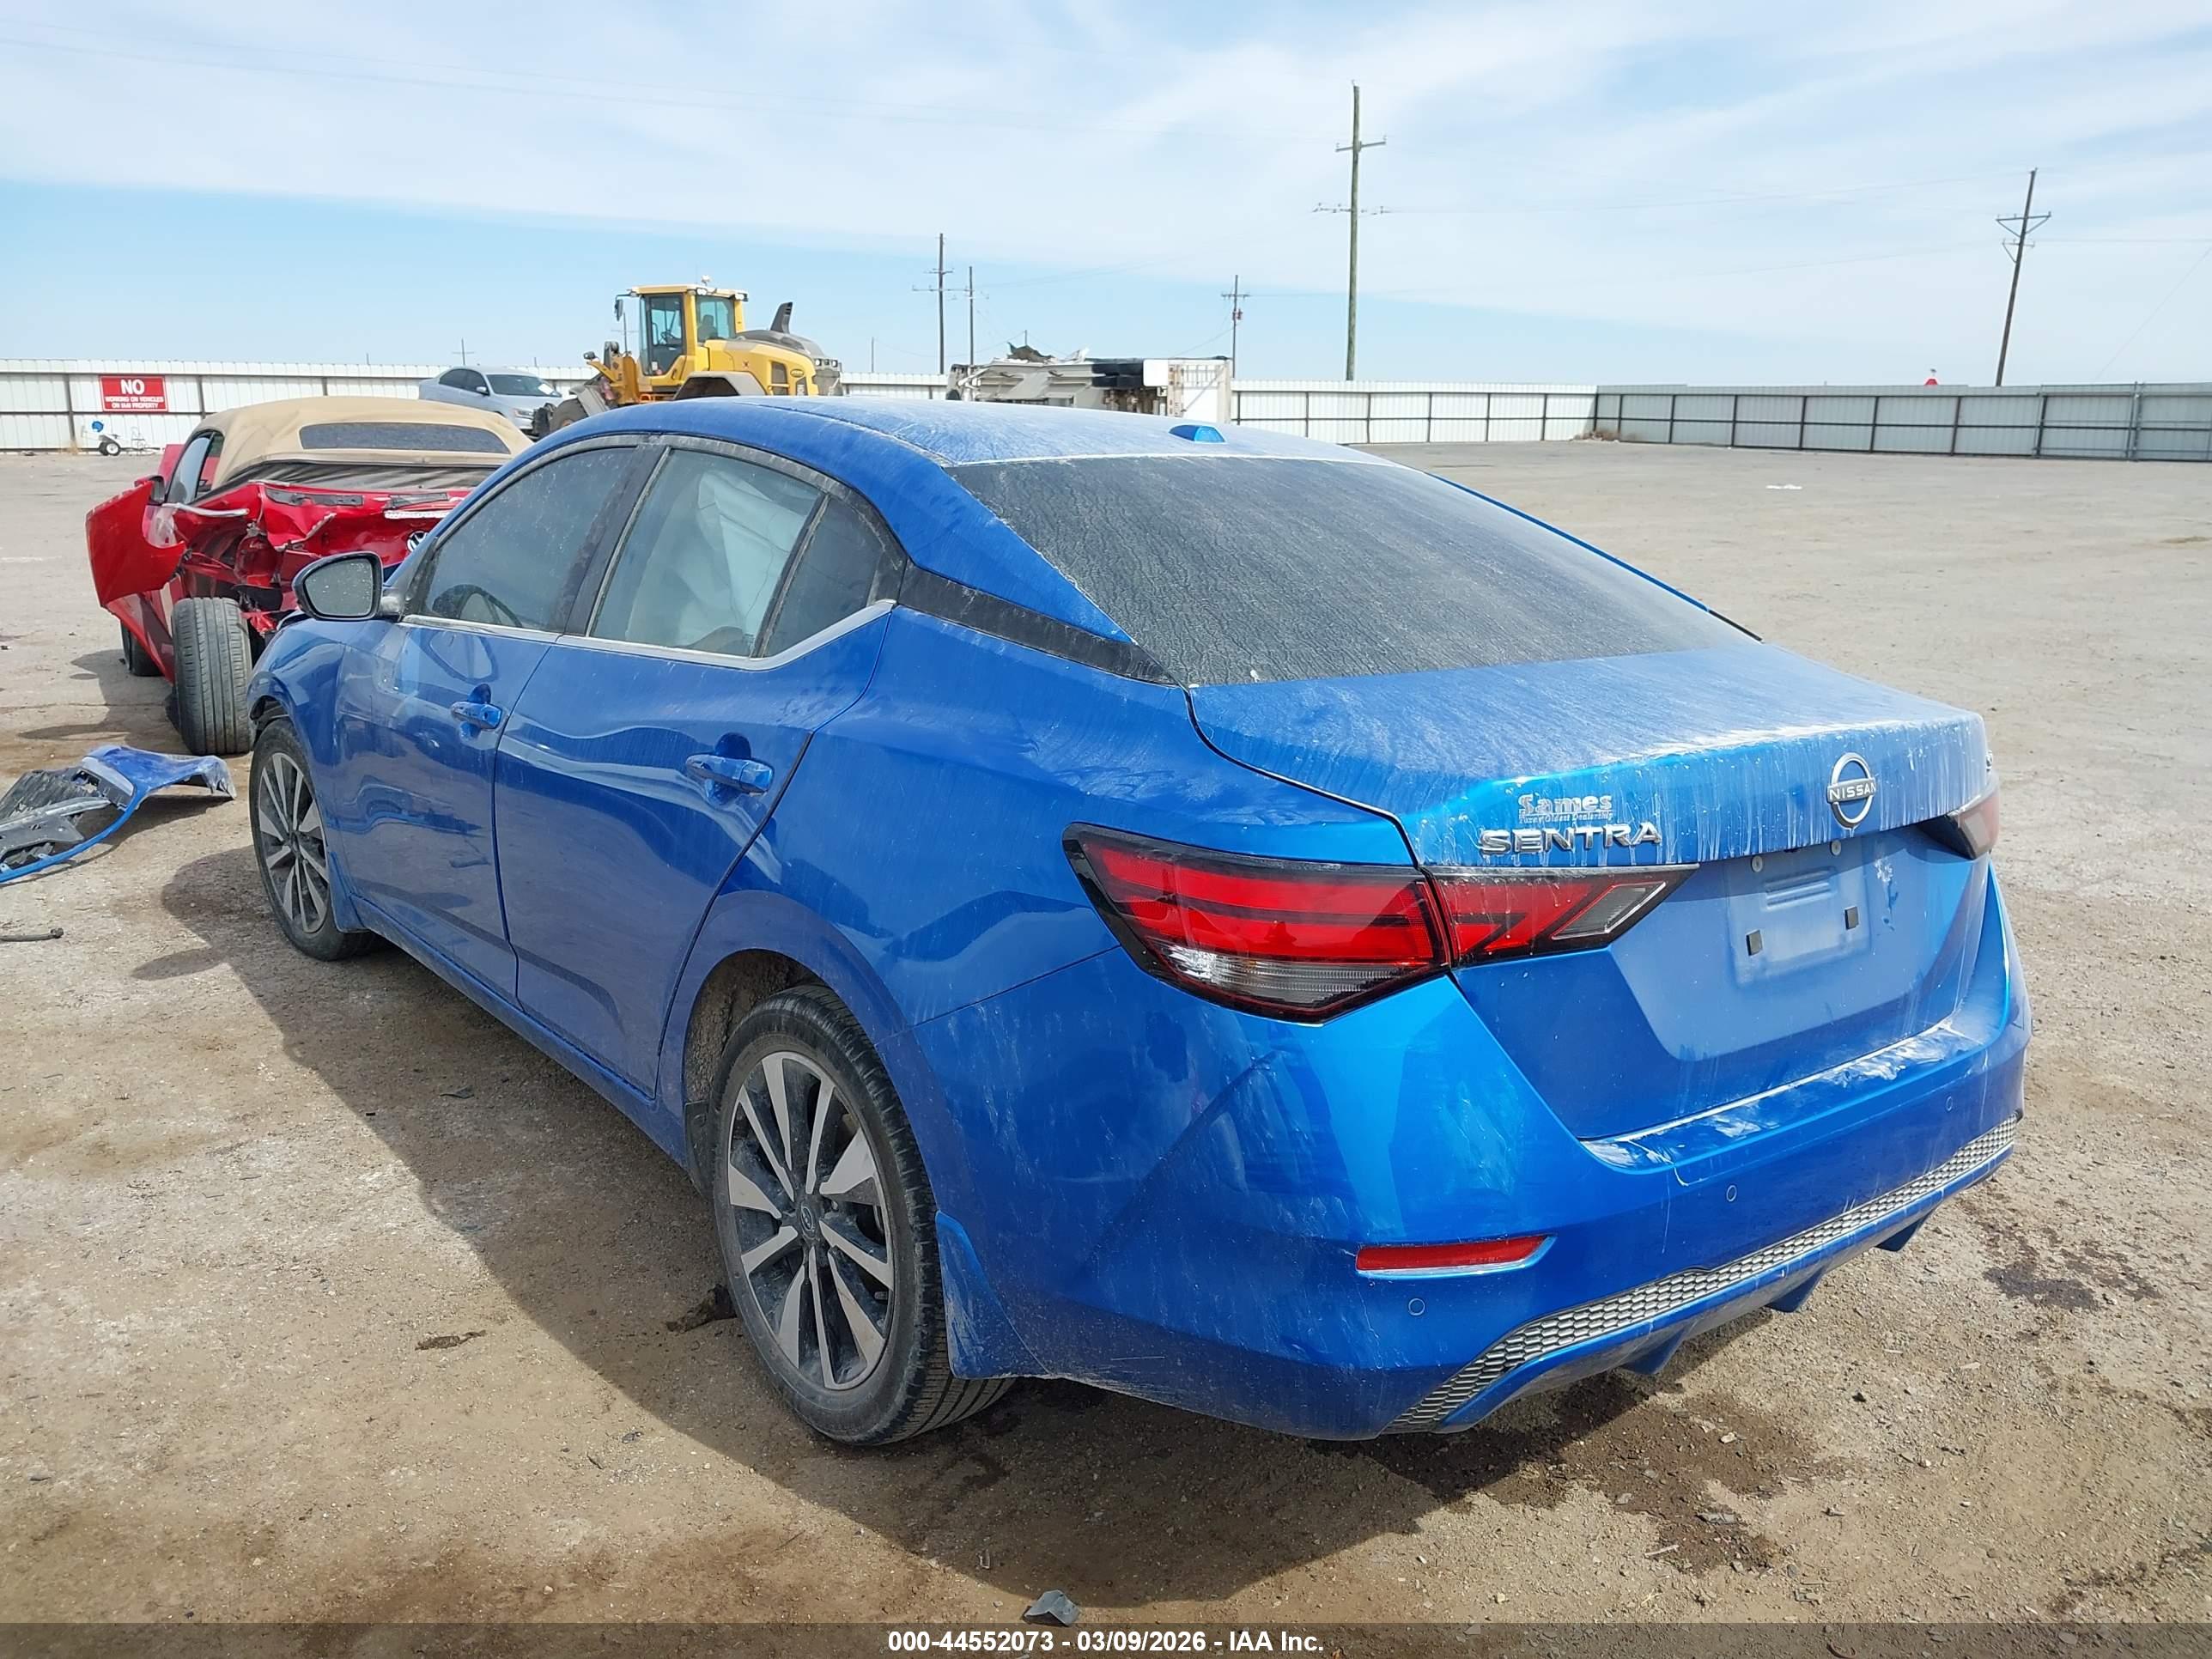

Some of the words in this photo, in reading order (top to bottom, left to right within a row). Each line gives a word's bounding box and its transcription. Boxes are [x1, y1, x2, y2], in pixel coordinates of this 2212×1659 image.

[120, 379, 145, 395] NO
[1828, 782, 1876, 800] NISSAN
[1517, 793, 1613, 815] Sames
[1480, 821, 1662, 854] SENTRA
